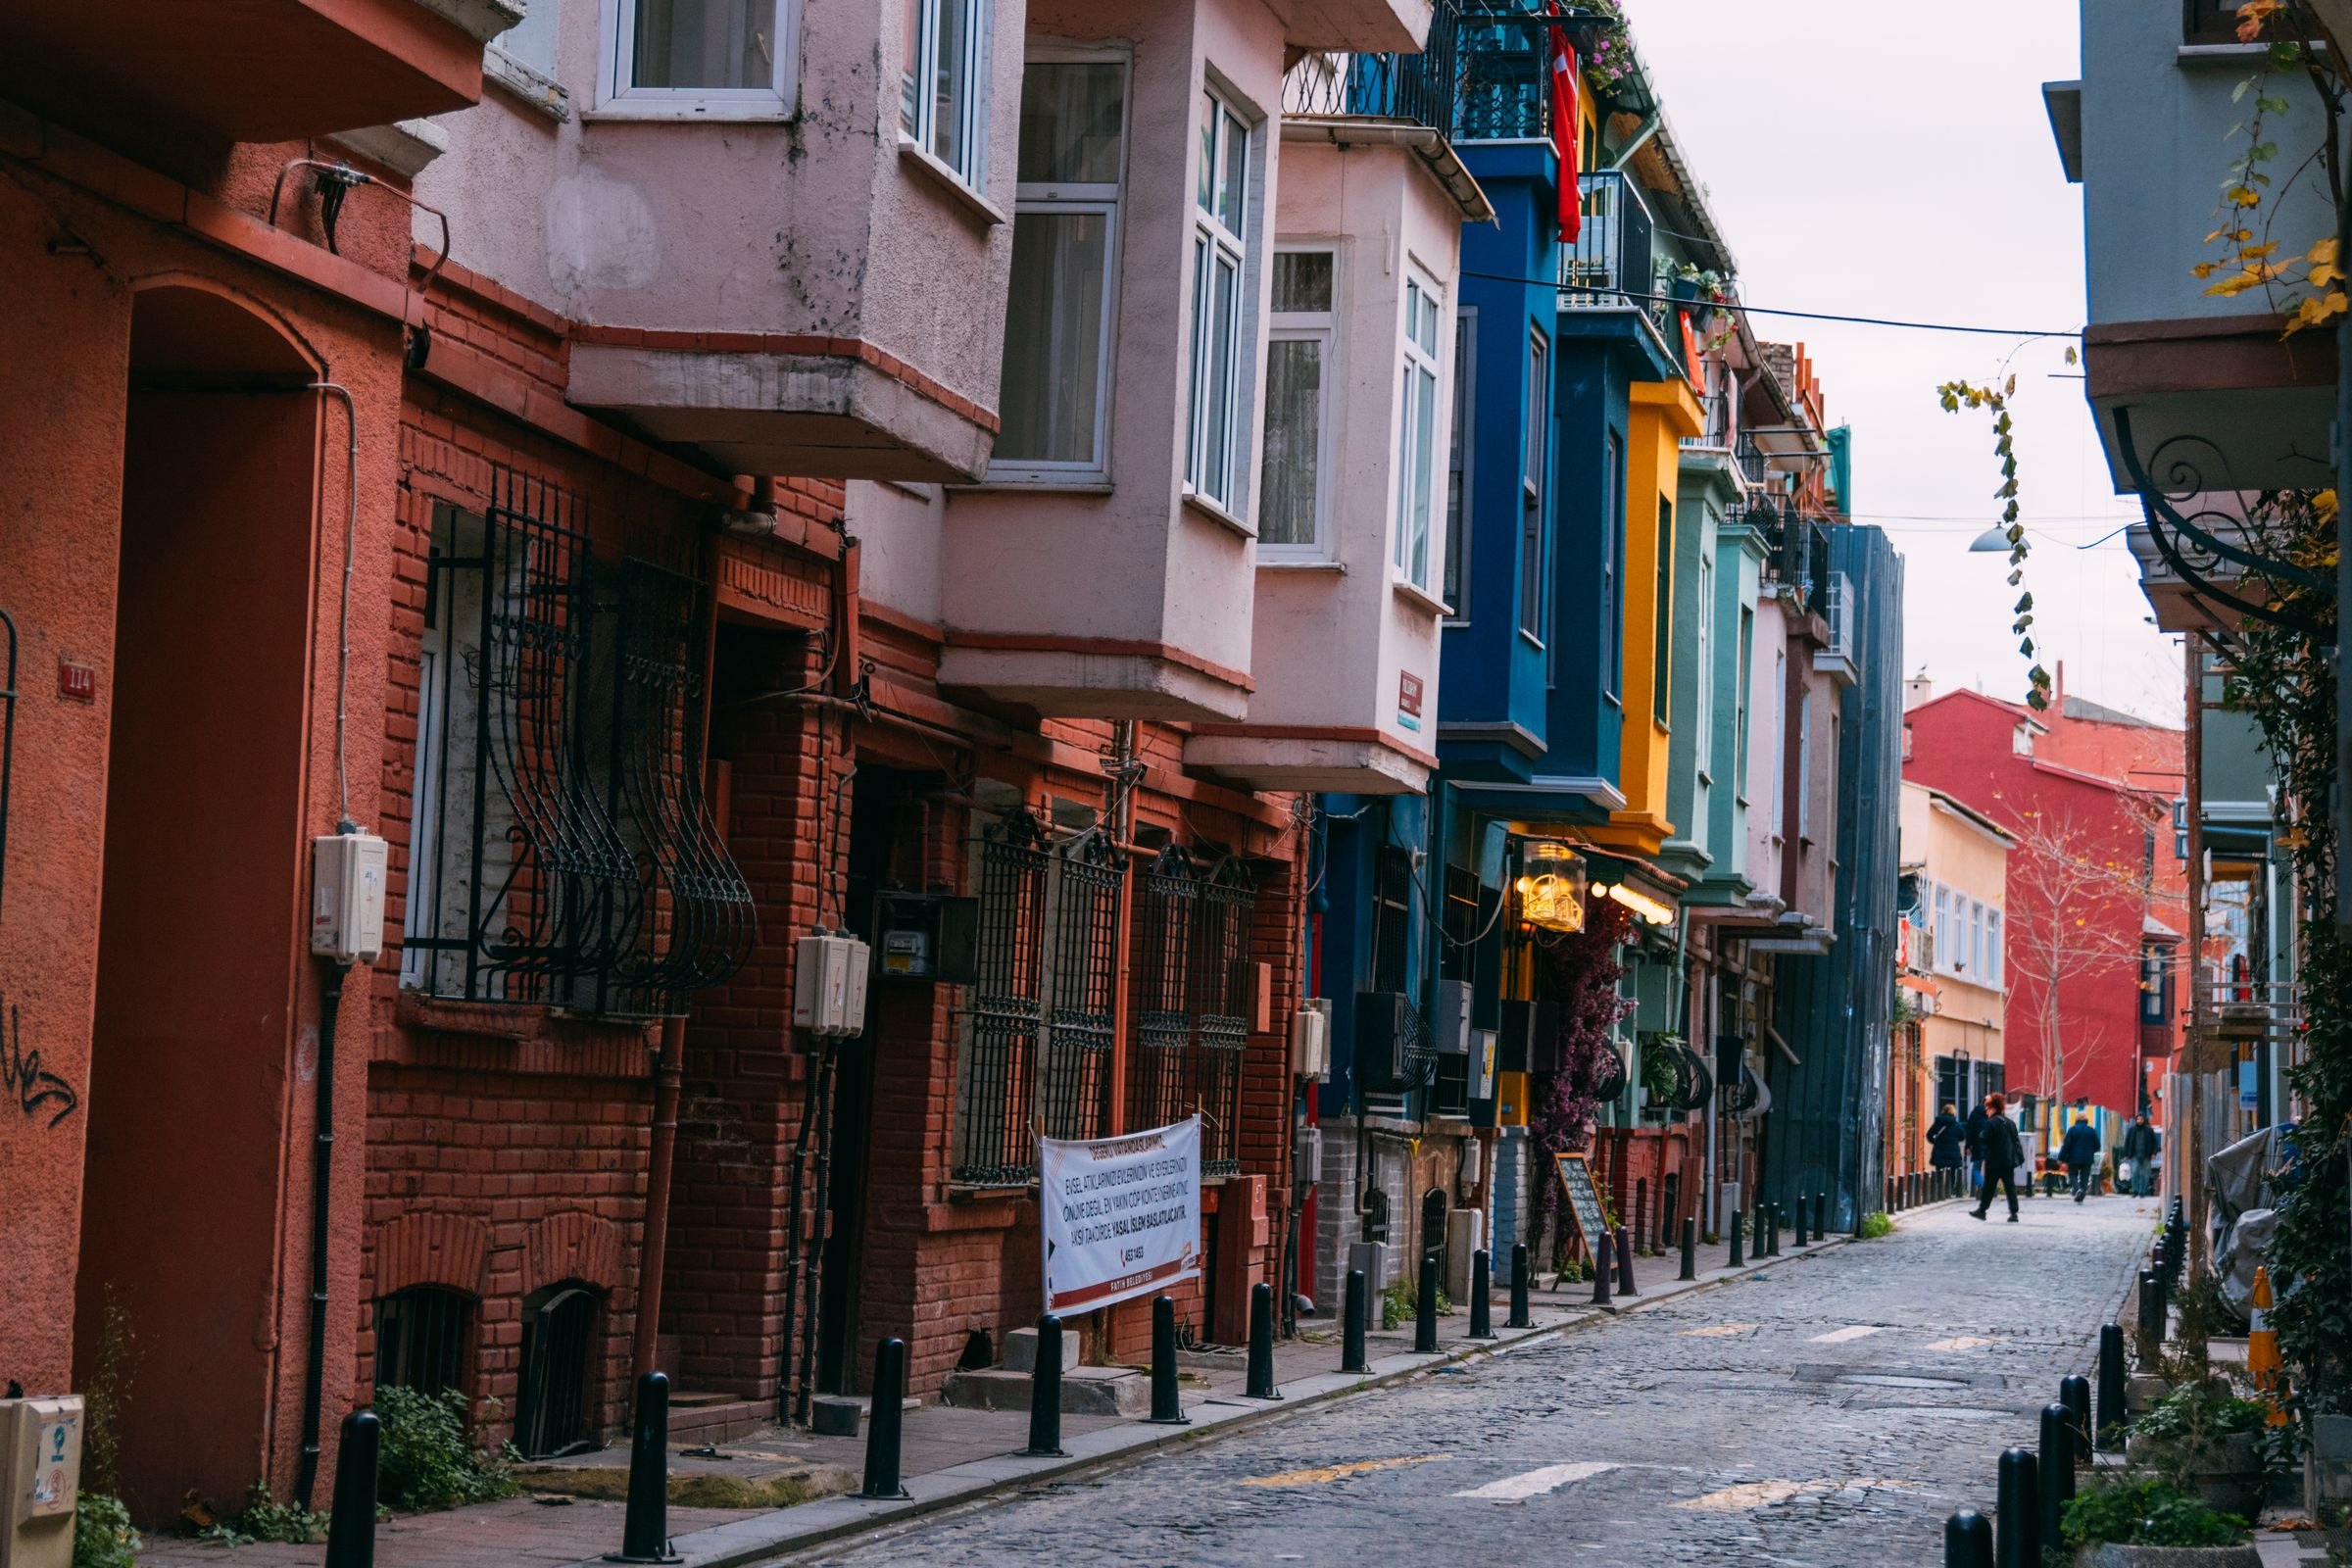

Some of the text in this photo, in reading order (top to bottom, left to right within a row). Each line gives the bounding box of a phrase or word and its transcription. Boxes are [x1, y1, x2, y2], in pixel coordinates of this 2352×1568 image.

[70, 668, 90, 691] 114
[1065, 1177, 1083, 1196] EVSEL
[1147, 1163, 1155, 1178] VE
[1103, 1198, 1112, 1213] EN
[1111, 1193, 1128, 1211] YAKIN
[1070, 1226, 1084, 1246] AKSİ
[1110, 1218, 1130, 1237] YASAL
